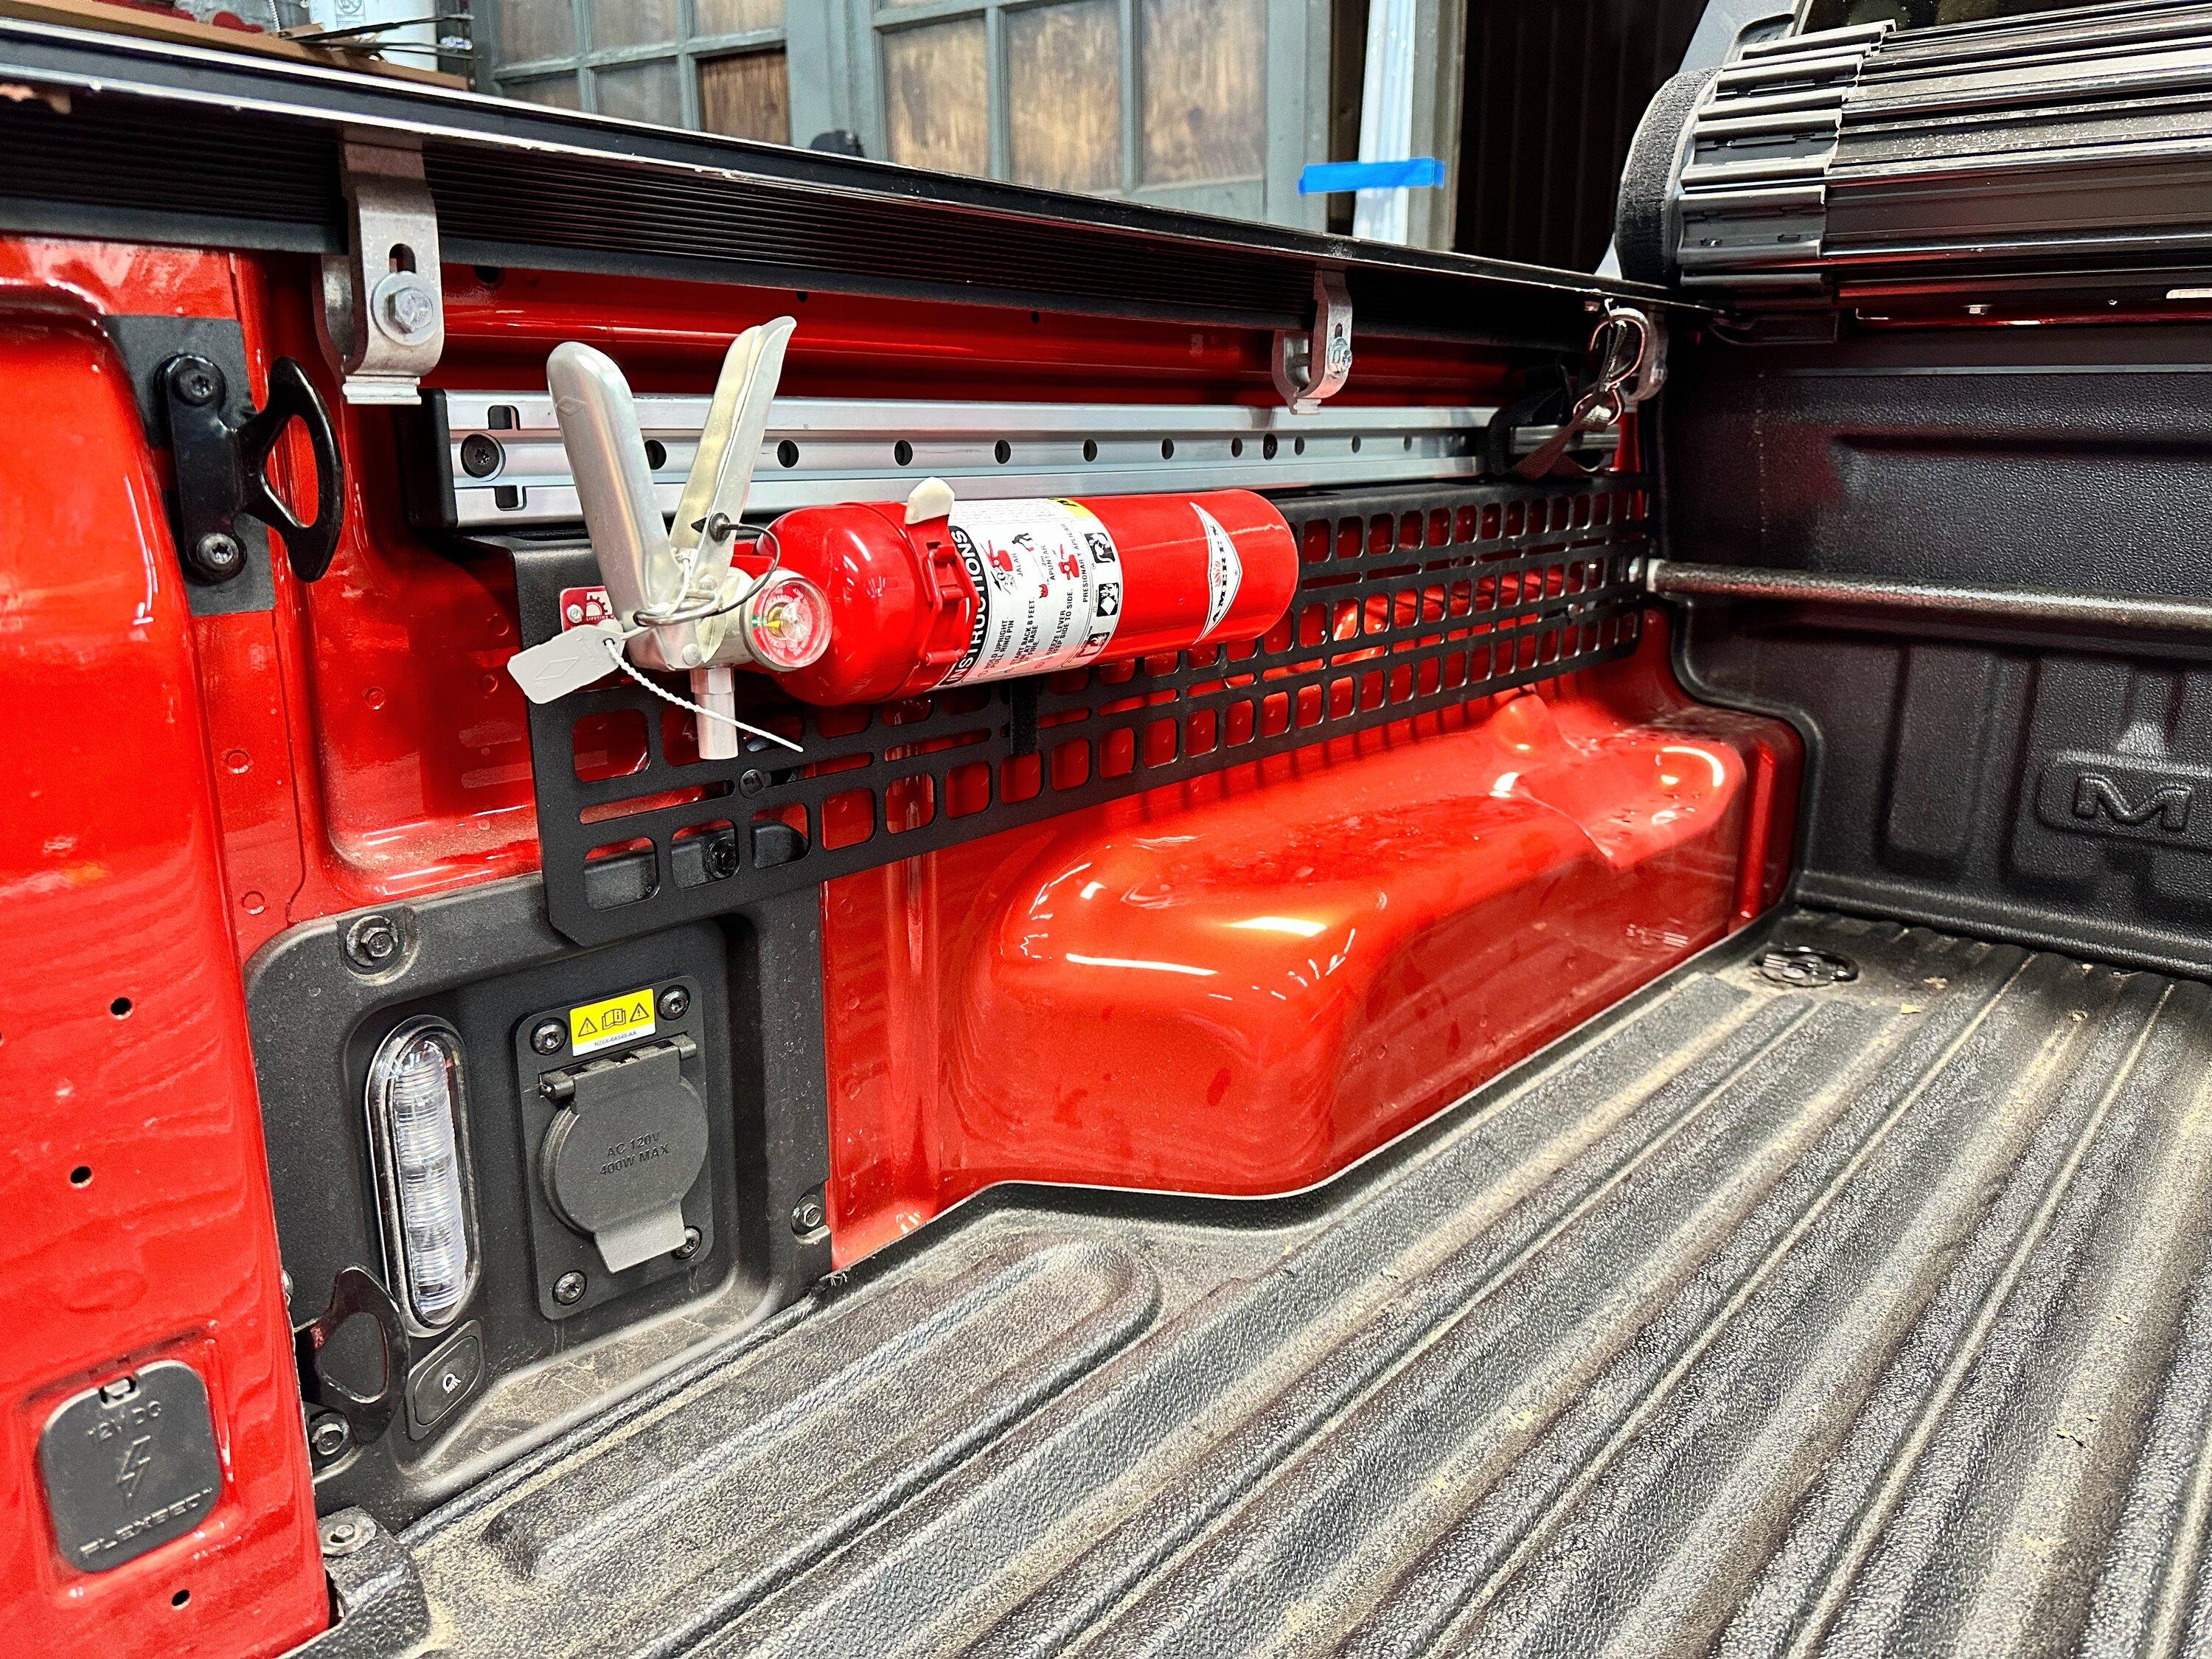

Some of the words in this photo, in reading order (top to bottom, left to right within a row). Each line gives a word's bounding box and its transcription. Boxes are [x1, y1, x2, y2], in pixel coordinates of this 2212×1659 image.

[1060, 524, 1080, 550] APLICAR
[1012, 553, 1023, 577] JALAR
[1041, 545, 1056, 580] APUNTAR
[1078, 559, 1088, 602] PRESIONAR
[1021, 627, 1032, 646] BACK
[1028, 625, 1039, 643] BASE
[1060, 623, 1070, 639] SIDE
[1065, 611, 1072, 622] TO
[984, 653, 998, 669] HOLD
[990, 653, 1004, 668] PULL
[1000, 635, 1011, 653] RING
[607, 1142, 626, 1158] AC
[629, 1130, 661, 1150] 120V
[599, 1154, 636, 1175] 400W
[639, 1143, 669, 1163] MAX
[131, 1400, 162, 1425] DC
